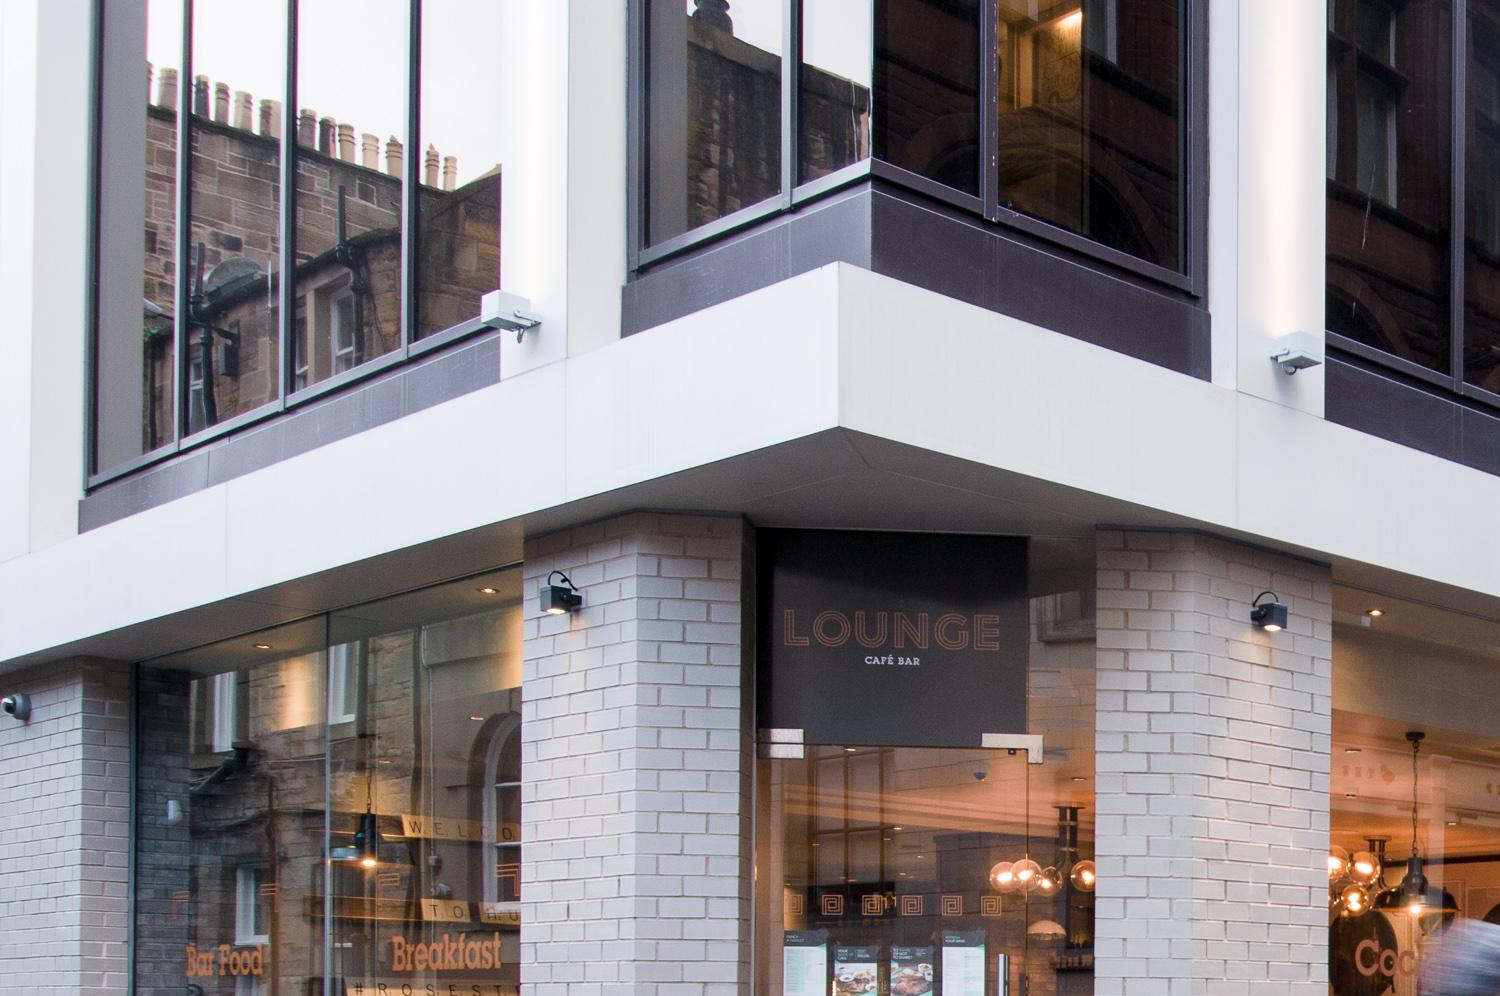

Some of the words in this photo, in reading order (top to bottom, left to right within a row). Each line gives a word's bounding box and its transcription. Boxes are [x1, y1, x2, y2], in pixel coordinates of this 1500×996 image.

[783, 608, 1000, 651] LOUNGE
[864, 654, 894, 666] CAFÉ
[897, 656, 920, 666] BAR
[429, 904, 464, 919] TO
[185, 945, 214, 977] Bar
[218, 943, 263, 977] Food
[391, 931, 502, 972] Breakfast
